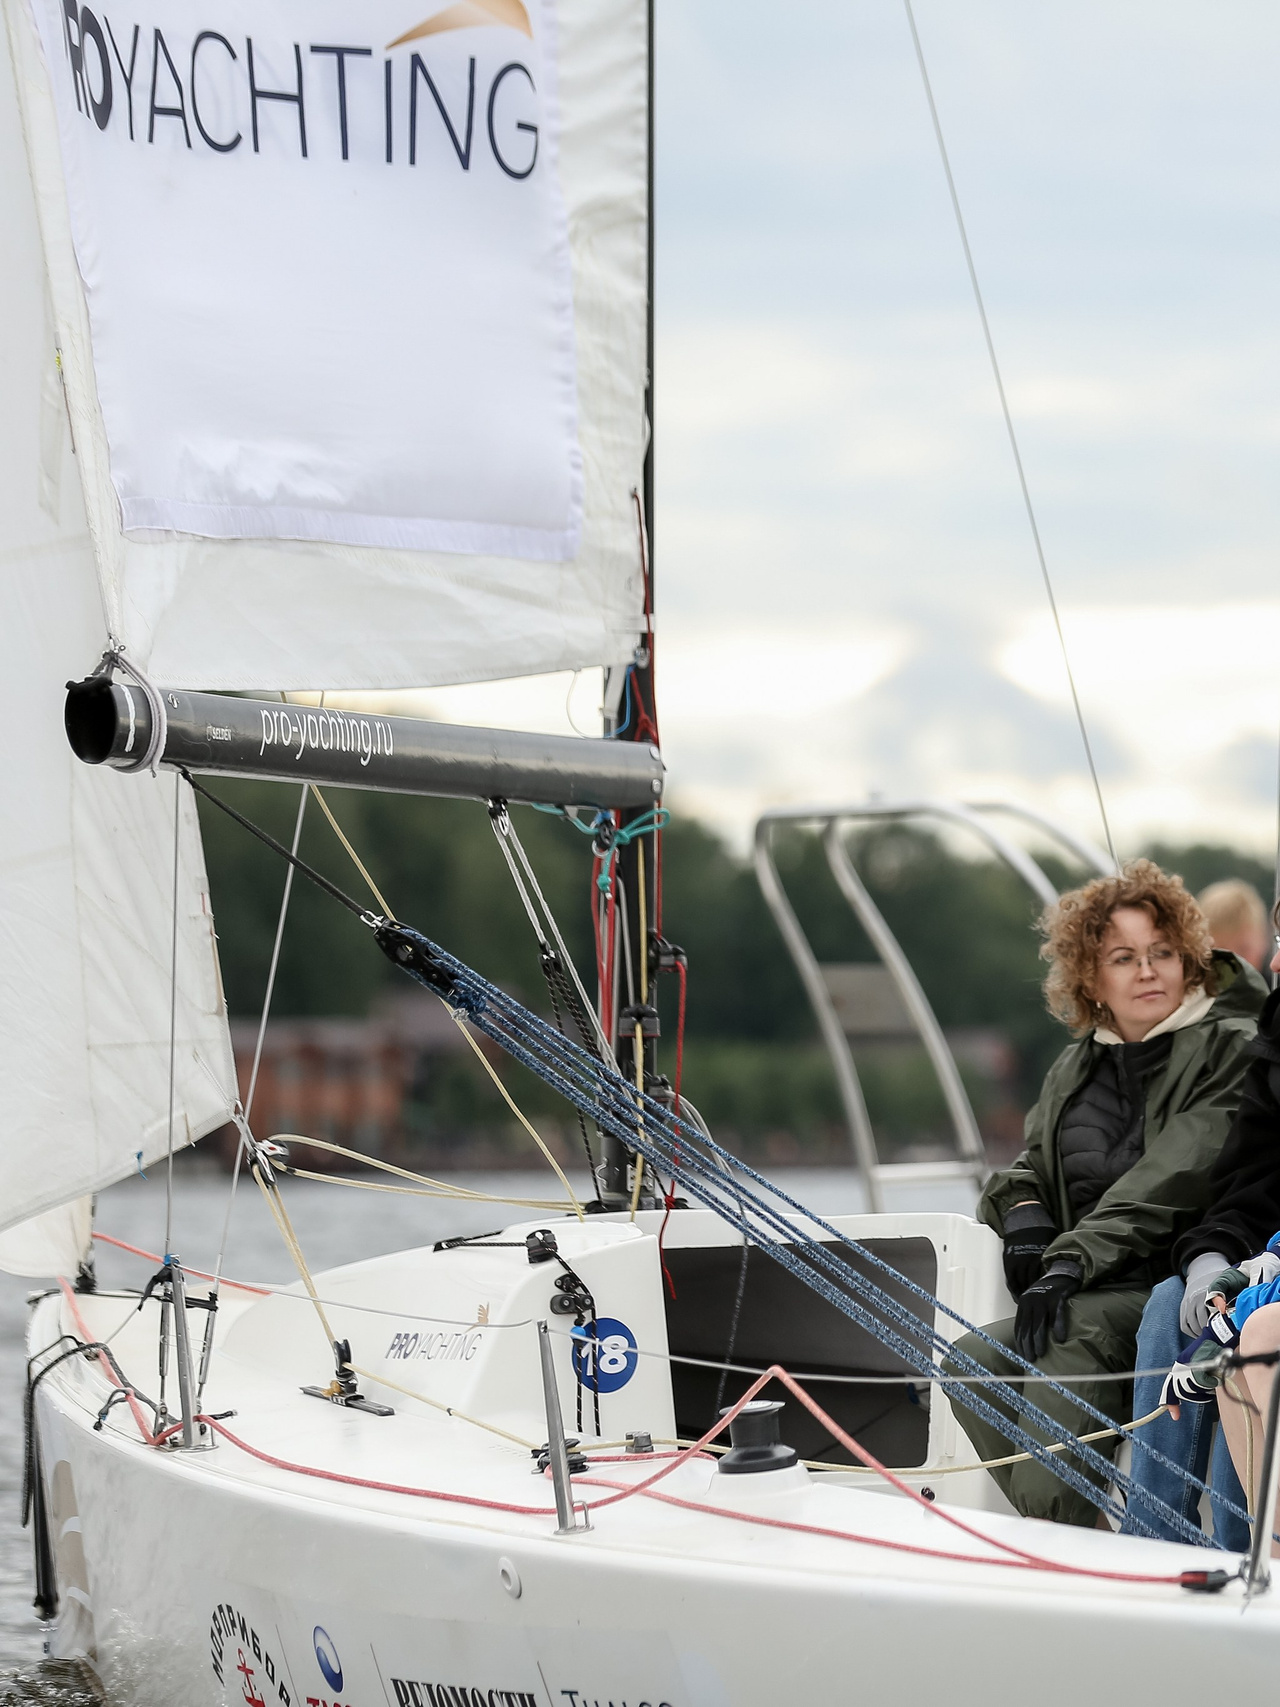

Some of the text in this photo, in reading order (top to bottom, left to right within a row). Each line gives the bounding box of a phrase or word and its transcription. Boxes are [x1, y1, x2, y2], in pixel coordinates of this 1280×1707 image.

[60, 0, 540, 180] ROYACHTING
[260, 707, 394, 767] pro-yachting.ru
[384, 1333, 483, 1361] PROYACHTING
[581, 1334, 630, 1378] 18
